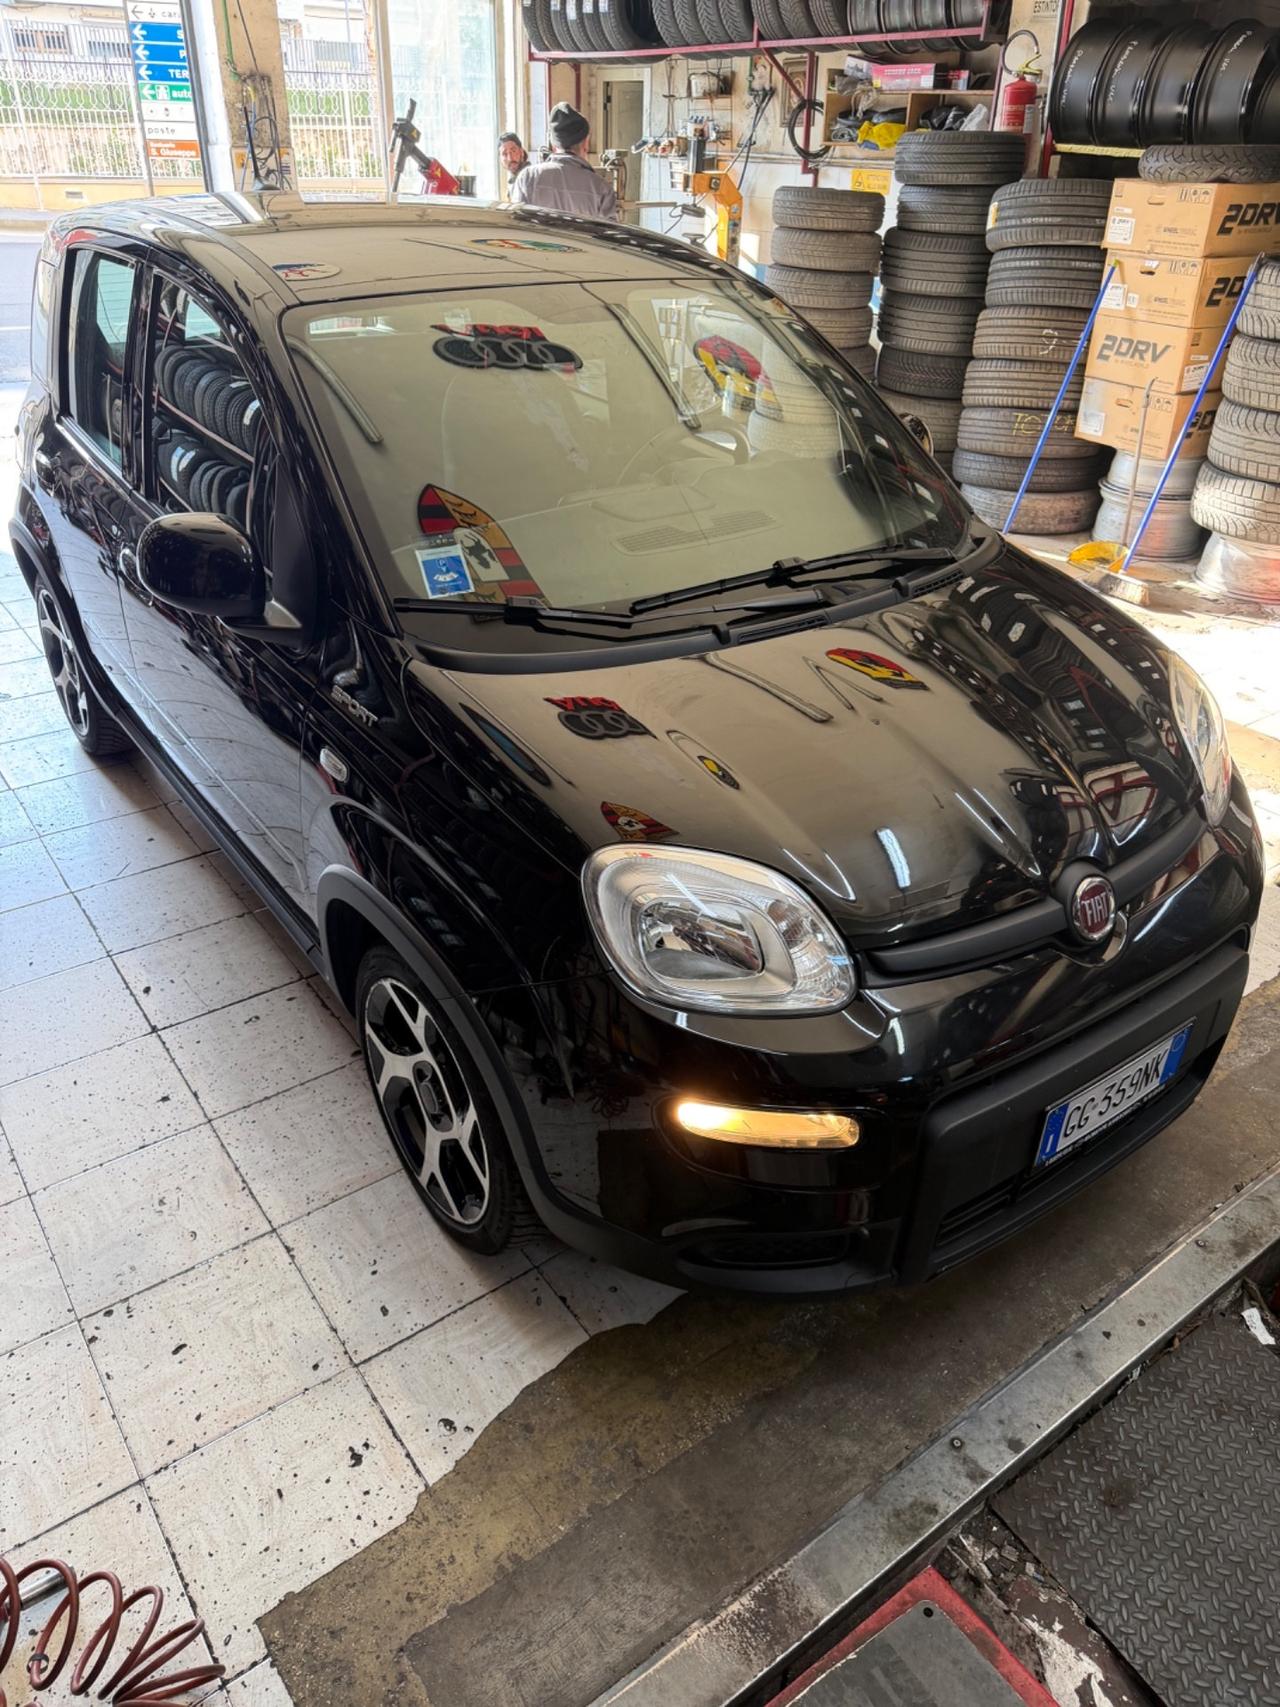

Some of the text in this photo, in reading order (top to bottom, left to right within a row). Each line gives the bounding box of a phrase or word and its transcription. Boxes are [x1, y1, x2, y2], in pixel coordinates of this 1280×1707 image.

[1216, 203, 1280, 236] 2DR
[1097, 334, 1172, 363] 2DRV
[331, 685, 378, 727] SPORT
[1081, 892, 1108, 926] FIAT
[1064, 1097, 1096, 1138] GG
[1098, 1047, 1170, 1116] 359NK
